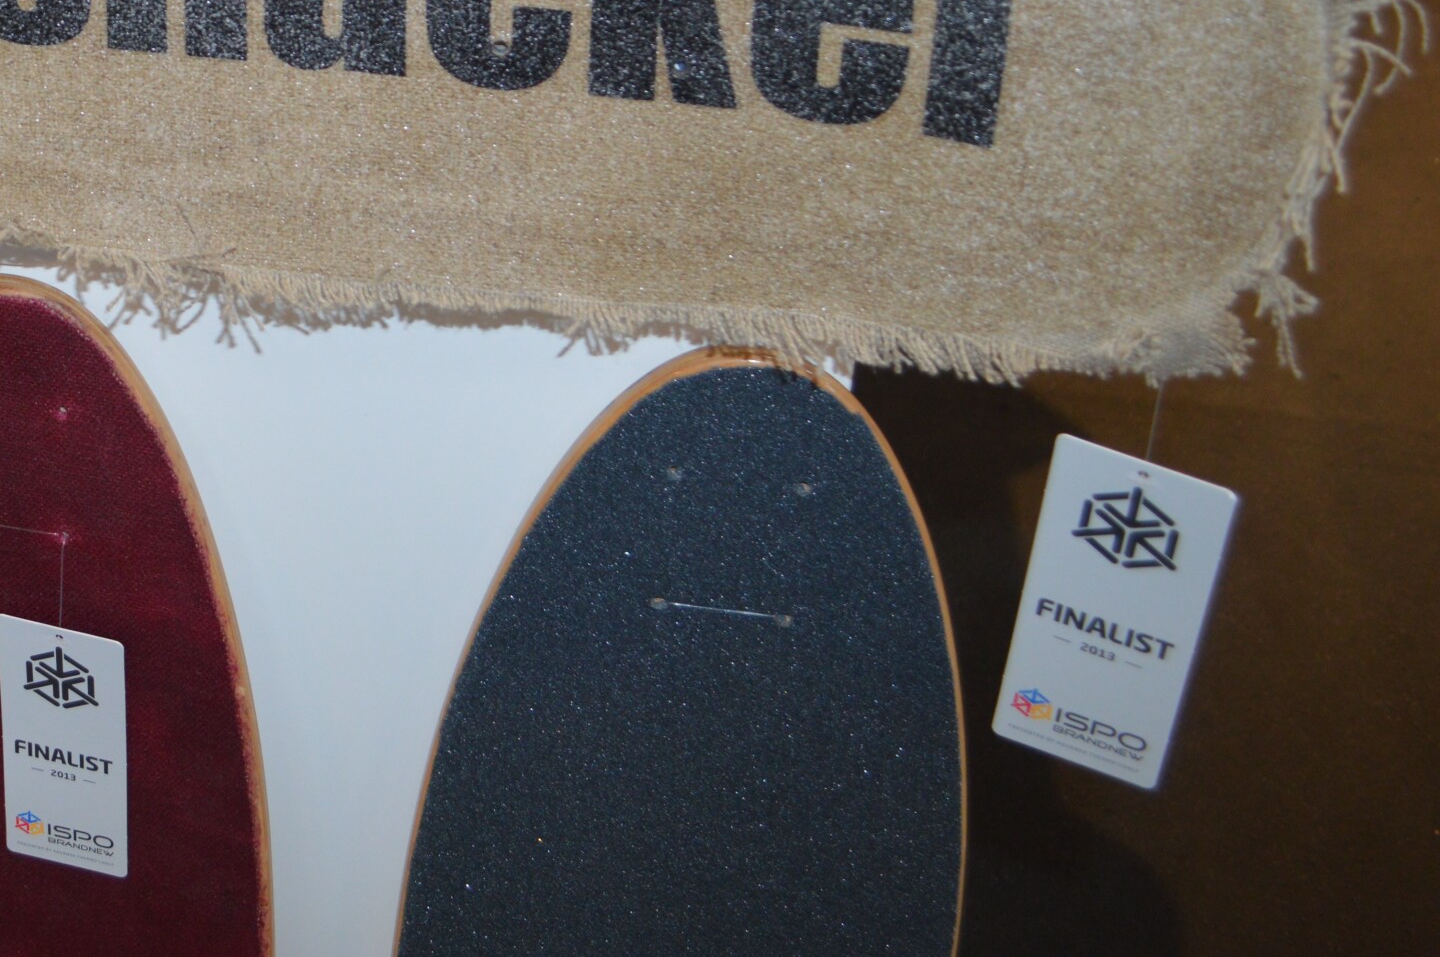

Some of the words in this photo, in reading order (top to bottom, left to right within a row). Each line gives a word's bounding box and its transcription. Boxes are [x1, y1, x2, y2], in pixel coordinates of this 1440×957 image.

[1035, 597, 1175, 661] FINALIST
[1079, 641, 1117, 662] 2013
[1051, 723, 1144, 763] BRANDNEW
[1054, 706, 1148, 752] ISPO
[14, 739, 113, 775] FINALIST
[50, 769, 77, 782] 2013
[47, 822, 115, 849] ISPO
[47, 837, 115, 857] BRANDNEW
